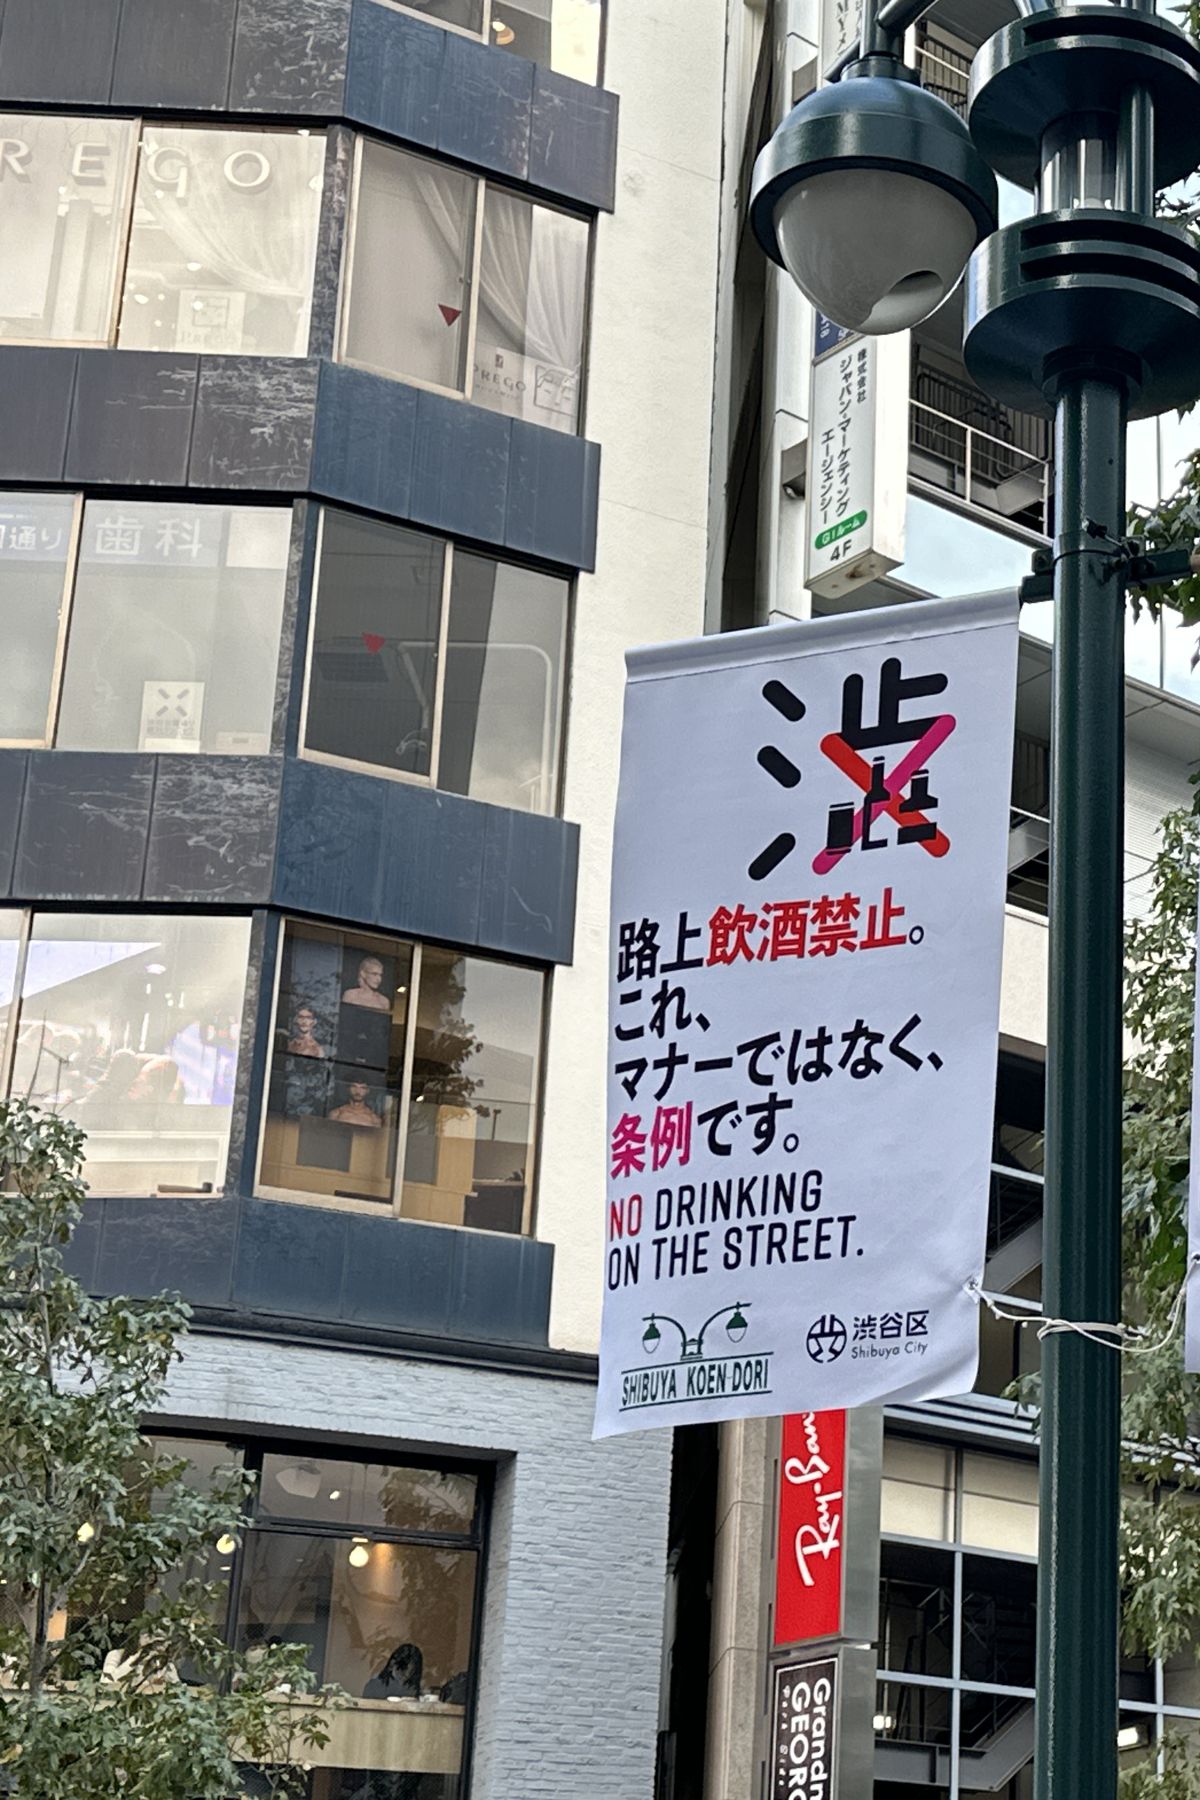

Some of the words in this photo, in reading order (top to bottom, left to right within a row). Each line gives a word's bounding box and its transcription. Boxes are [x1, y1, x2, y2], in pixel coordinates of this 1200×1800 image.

[819, 428, 835, 525] エージェンシー
[94, 515, 203, 558] 歯科
[829, 539, 852, 561] 4F
[616, 888, 924, 983] 路上飲酒禁止。
[615, 979, 711, 1041] これ、
[614, 1013, 944, 1101] マナーではなく、
[610, 1092, 800, 1180] 条例です。
[610, 1194, 643, 1242] NO
[655, 1169, 823, 1231] DRINKING
[608, 1243, 640, 1291] ON
[651, 1231, 710, 1280] THE
[723, 1214, 864, 1270] STREET.
[851, 1344, 900, 1361] Shibuya
[904, 1341, 929, 1357] City
[852, 1310, 930, 1341] 渋谷区
[621, 1373, 677, 1406] SHIBUYA
